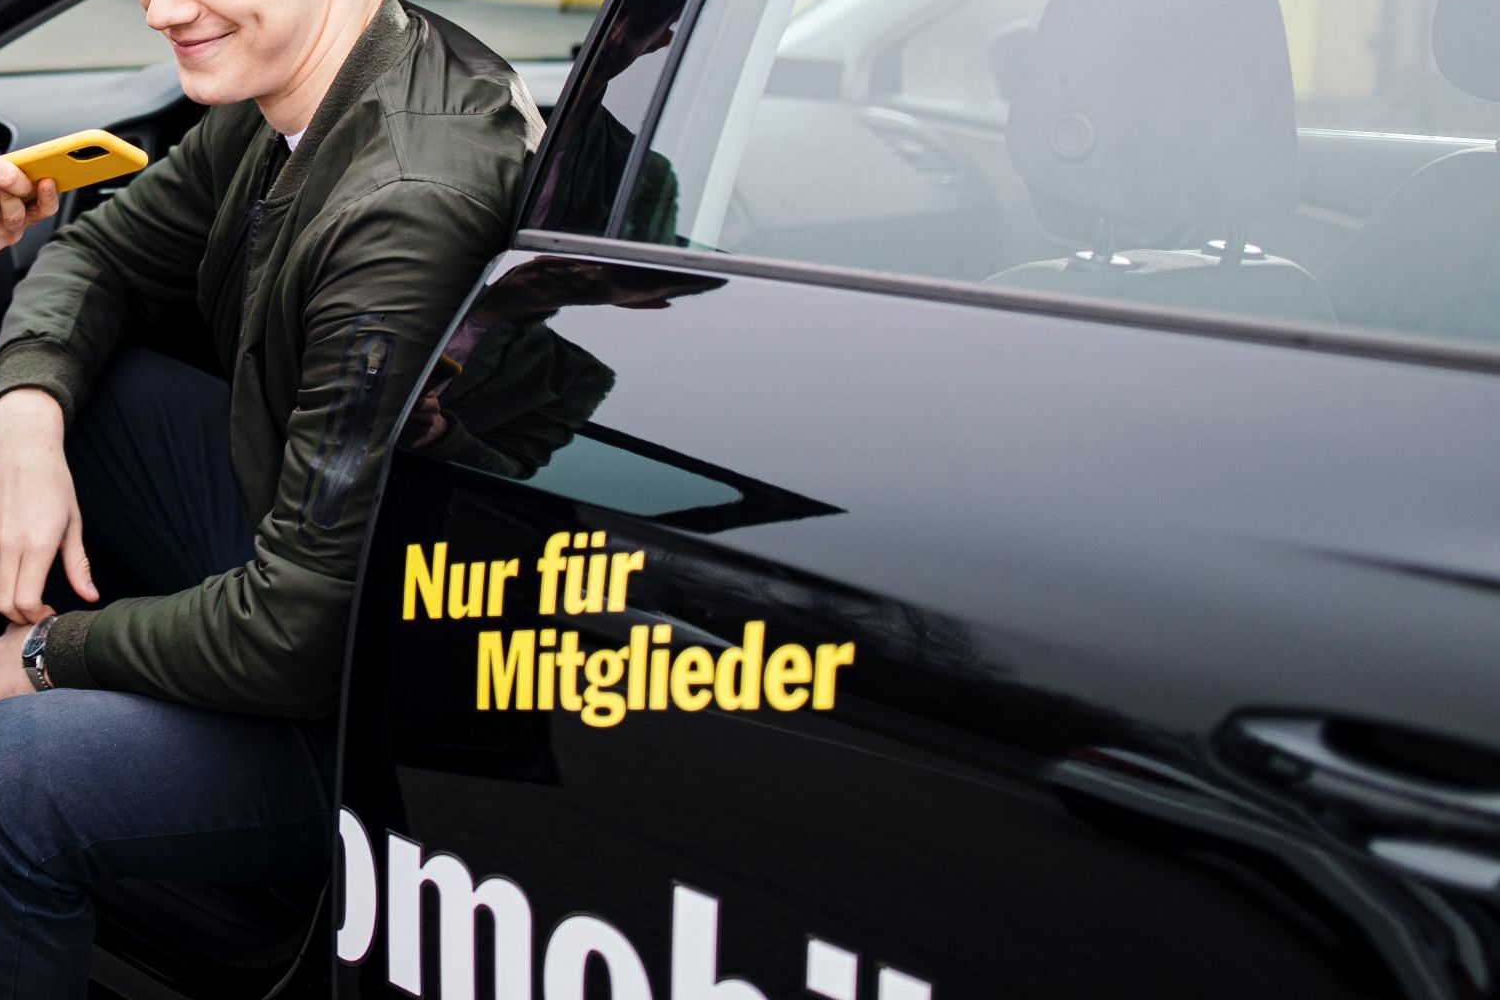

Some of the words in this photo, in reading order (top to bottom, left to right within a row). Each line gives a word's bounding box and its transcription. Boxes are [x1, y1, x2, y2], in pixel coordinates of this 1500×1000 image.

[402, 542, 519, 620] Nur
[537, 531, 645, 615] für
[476, 621, 855, 728] Mitglieder
